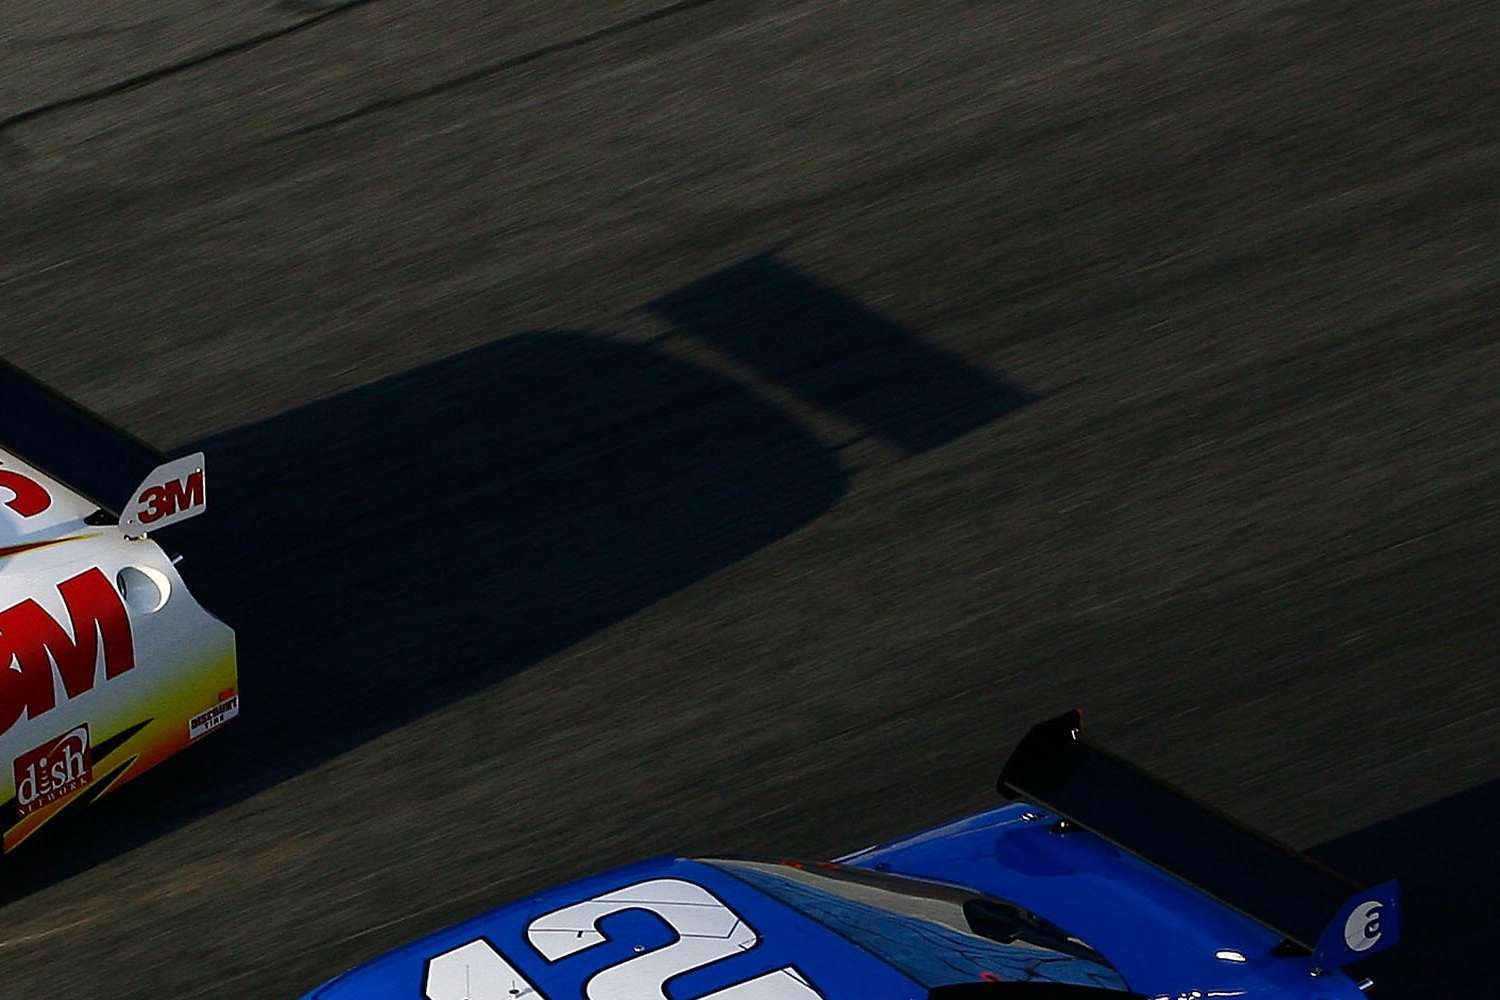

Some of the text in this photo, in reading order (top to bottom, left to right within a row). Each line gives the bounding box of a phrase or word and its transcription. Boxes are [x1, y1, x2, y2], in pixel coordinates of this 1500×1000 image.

[137, 471, 204, 524] 3M
[191, 697, 238, 730] DISCOUNT
[18, 743, 87, 805] dish
